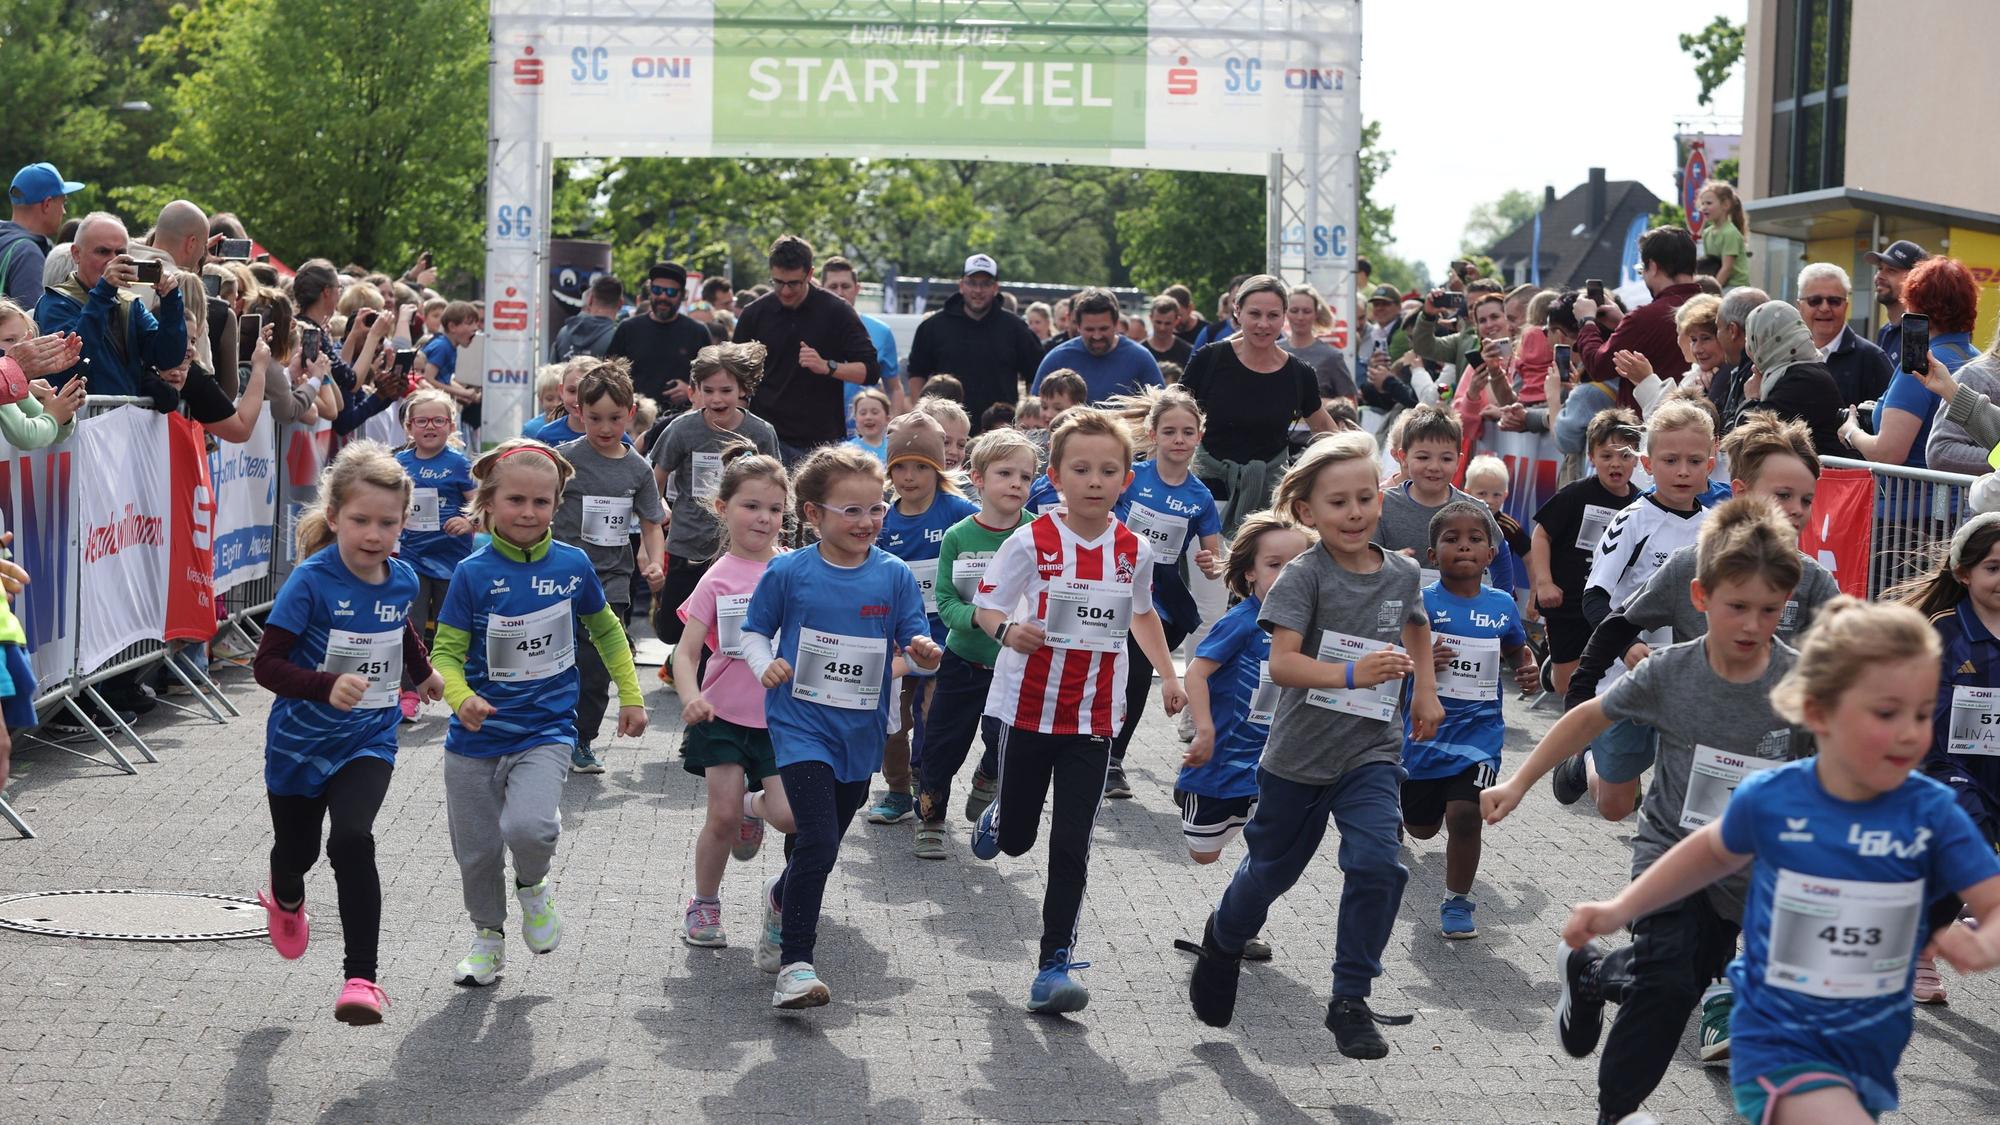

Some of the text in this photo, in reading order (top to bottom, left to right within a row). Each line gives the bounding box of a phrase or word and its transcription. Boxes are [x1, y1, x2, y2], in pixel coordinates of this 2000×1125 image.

[570, 46, 608, 81] SC
[631, 57, 691, 78] ONI
[748, 56, 1112, 106] START ZIEL
[1225, 57, 1261, 92] SC
[1284, 68, 1343, 90] ONI
[497, 205, 532, 237] SC
[1313, 225, 1347, 257] SC
[488, 369, 528, 385] ONI
[603, 516, 624, 524] 133
[1142, 528, 1168, 542] 458
[1038, 563, 1063, 572] erima
[1076, 606, 1115, 620] 504
[516, 634, 553, 651] 457
[822, 637, 839, 646] ONI
[1347, 640, 1364, 650] ONI
[356, 660, 390, 674] 451
[824, 662, 863, 676] 488
[1449, 660, 1480, 672] 461
[1954, 726, 1995, 742] LINA
[1724, 757, 1744, 768] ONI
[1818, 926, 1882, 945] 453
